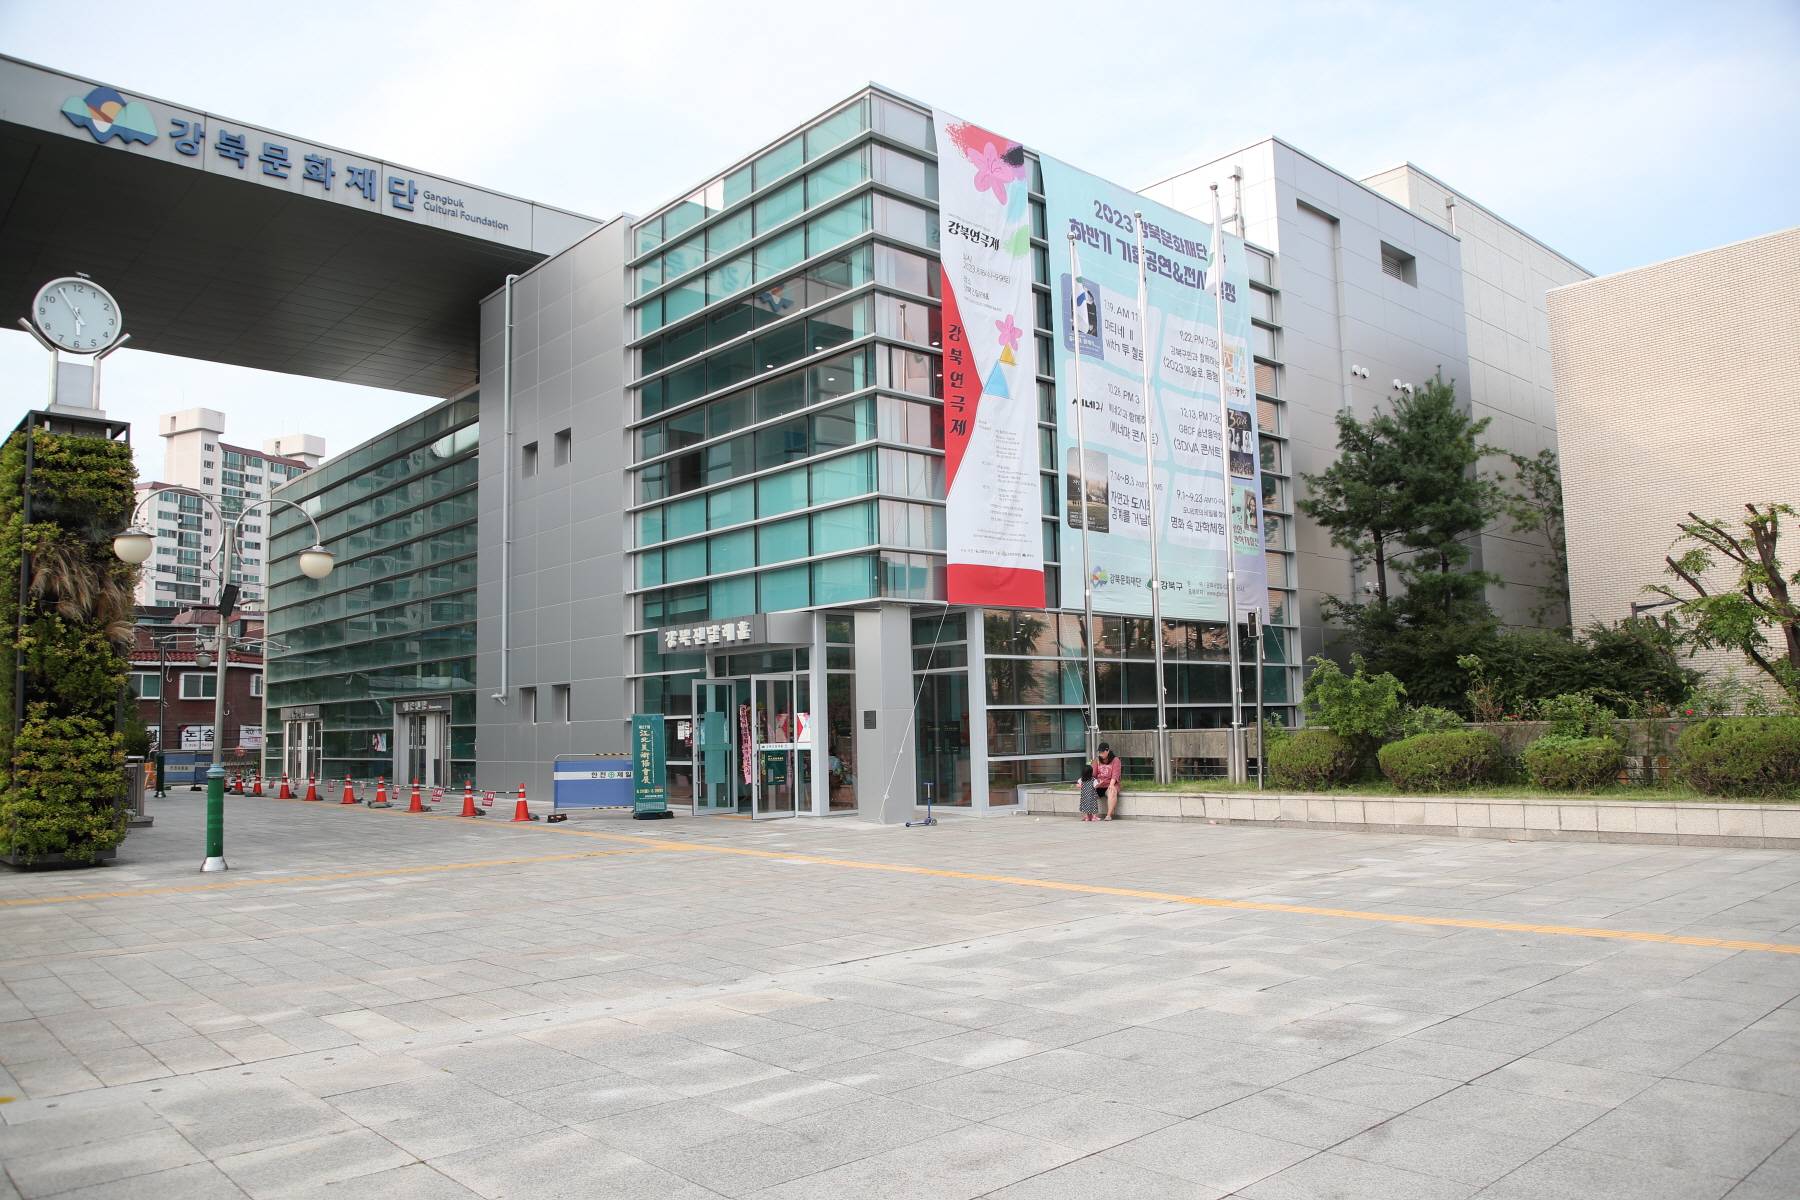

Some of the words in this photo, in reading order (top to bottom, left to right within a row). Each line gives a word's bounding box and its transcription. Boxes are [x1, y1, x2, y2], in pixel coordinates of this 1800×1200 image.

[169, 118, 419, 212] 강북문화재단
[423, 190, 464, 208] Gangbuk
[424, 202, 458, 218] Cultural
[460, 210, 509, 231] Foundation
[1094, 200, 1134, 234] 2023
[948, 220, 1000, 251] 강북연극제
[1069, 218, 1112, 255] 하반기
[72, 285, 84, 293] 12
[1116, 306, 1130, 319] AM
[1131, 312, 1138, 322] 11
[1104, 319, 1124, 338] 마티네
[1106, 338, 1120, 352] with
[1122, 344, 1130, 356] 투
[948, 324, 967, 436] 강북연극제
[1123, 390, 1134, 402] PM
[1198, 411, 1208, 422] PM
[1110, 490, 1130, 507] 자연과
[1171, 516, 1184, 530] 명화
[1187, 520, 1194, 532] 속
[1110, 574, 1142, 588] 강북문화재단
[1160, 580, 1183, 591] 강북구
[665, 620, 751, 648] 강북진달래홀
[184, 729, 214, 742] 논술
[640, 730, 652, 784] 江北美術協會展
